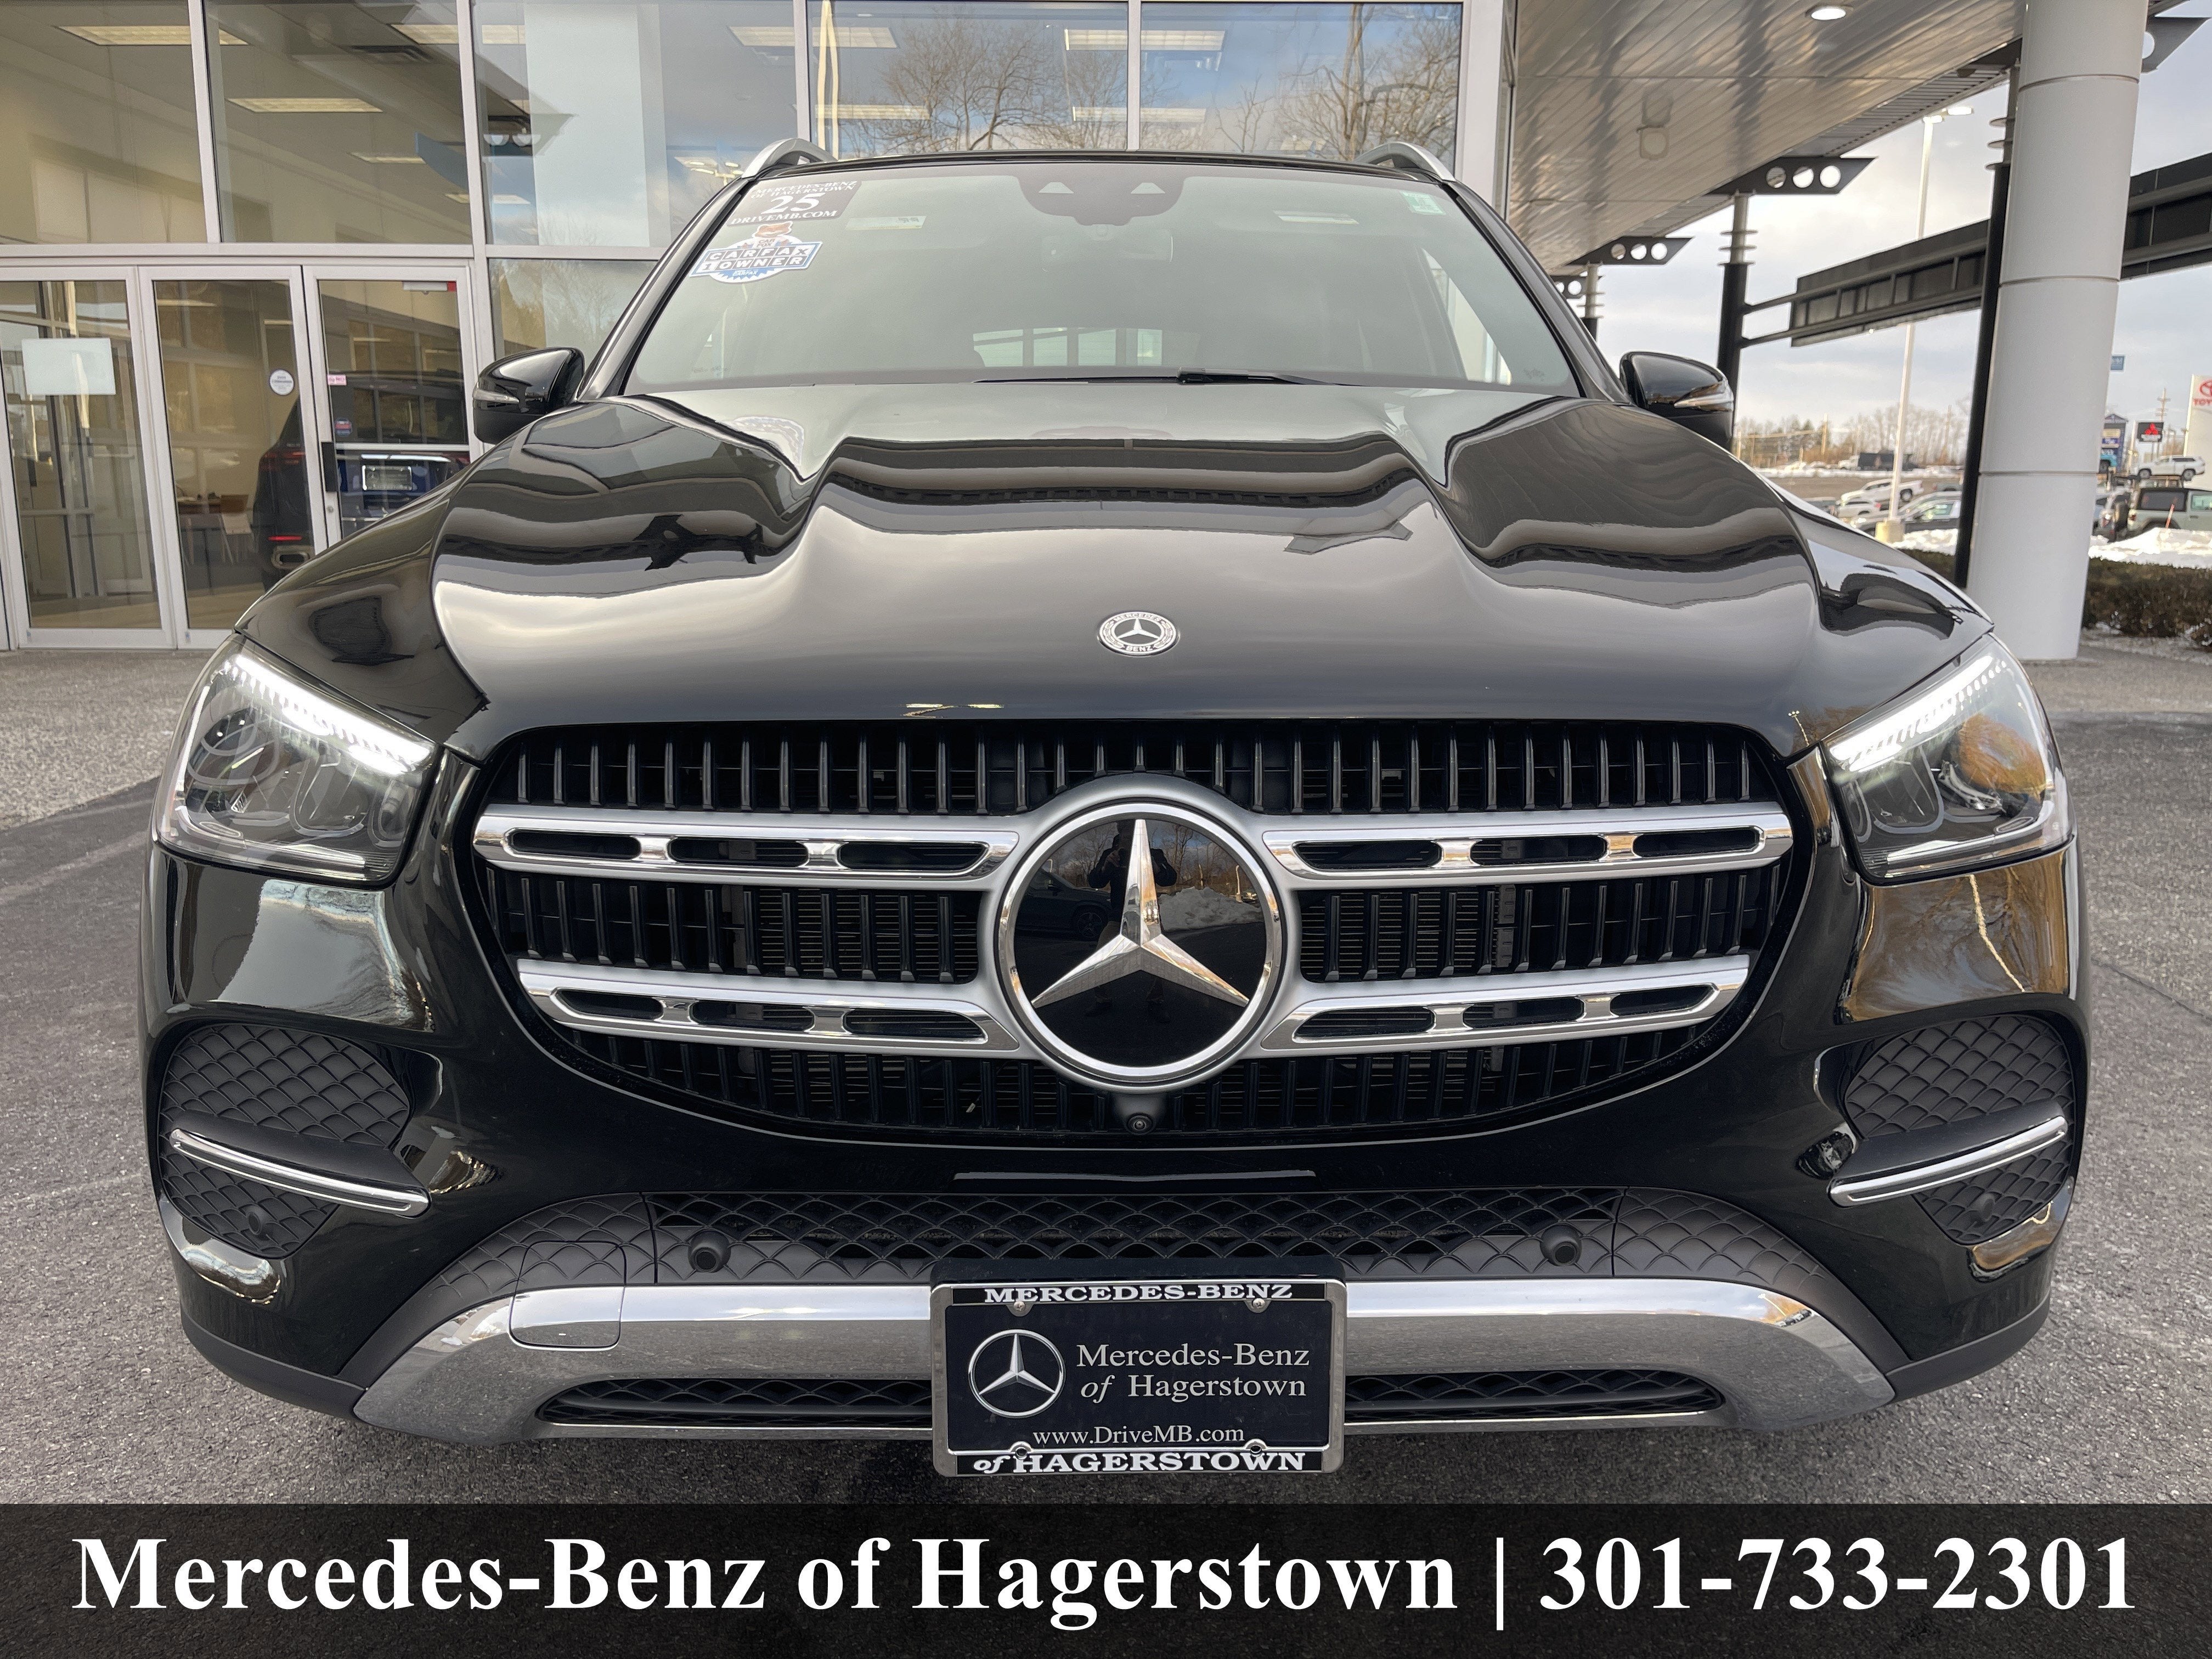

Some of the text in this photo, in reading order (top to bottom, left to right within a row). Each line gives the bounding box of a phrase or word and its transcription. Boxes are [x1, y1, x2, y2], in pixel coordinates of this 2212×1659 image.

[761, 193, 826, 215] 25
[731, 210, 838, 224] DRIVEMB.COM
[702, 256, 804, 271] 1 OWNER
[709, 247, 809, 261] CARFAX
[985, 1284, 1293, 1303] MERCEDES-BENZ
[1076, 1343, 1310, 1367] Mercedes-Benz
[1081, 1374, 1307, 1403] of Hagerstown
[1032, 1425, 1245, 1444] www.DriveMB.com
[973, 1452, 1306, 1474] of HAGERSTOWN
